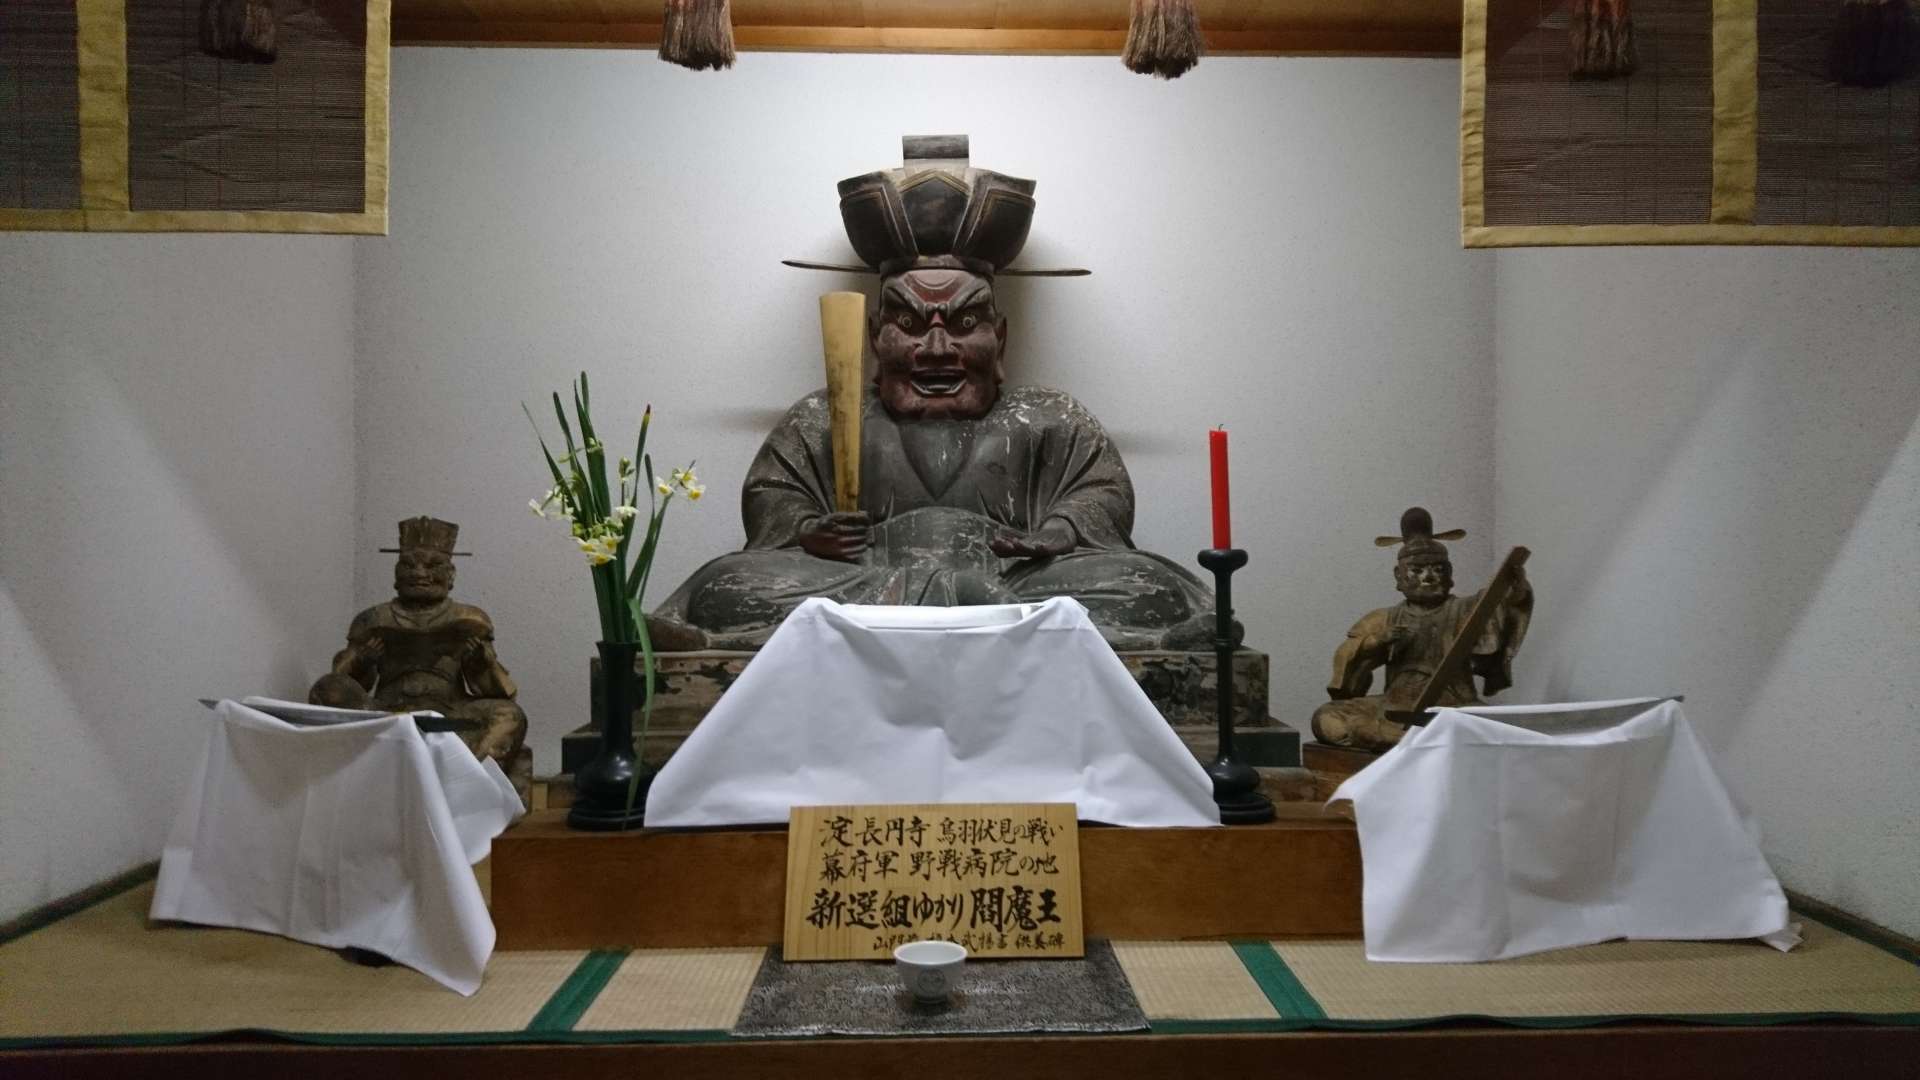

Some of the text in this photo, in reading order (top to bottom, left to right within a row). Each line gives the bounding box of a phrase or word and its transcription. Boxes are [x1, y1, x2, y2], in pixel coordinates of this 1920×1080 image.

[820, 849, 900, 886] 幕府軍
[805, 885, 1062, 932] 新選組ゆかり 閻魔王
